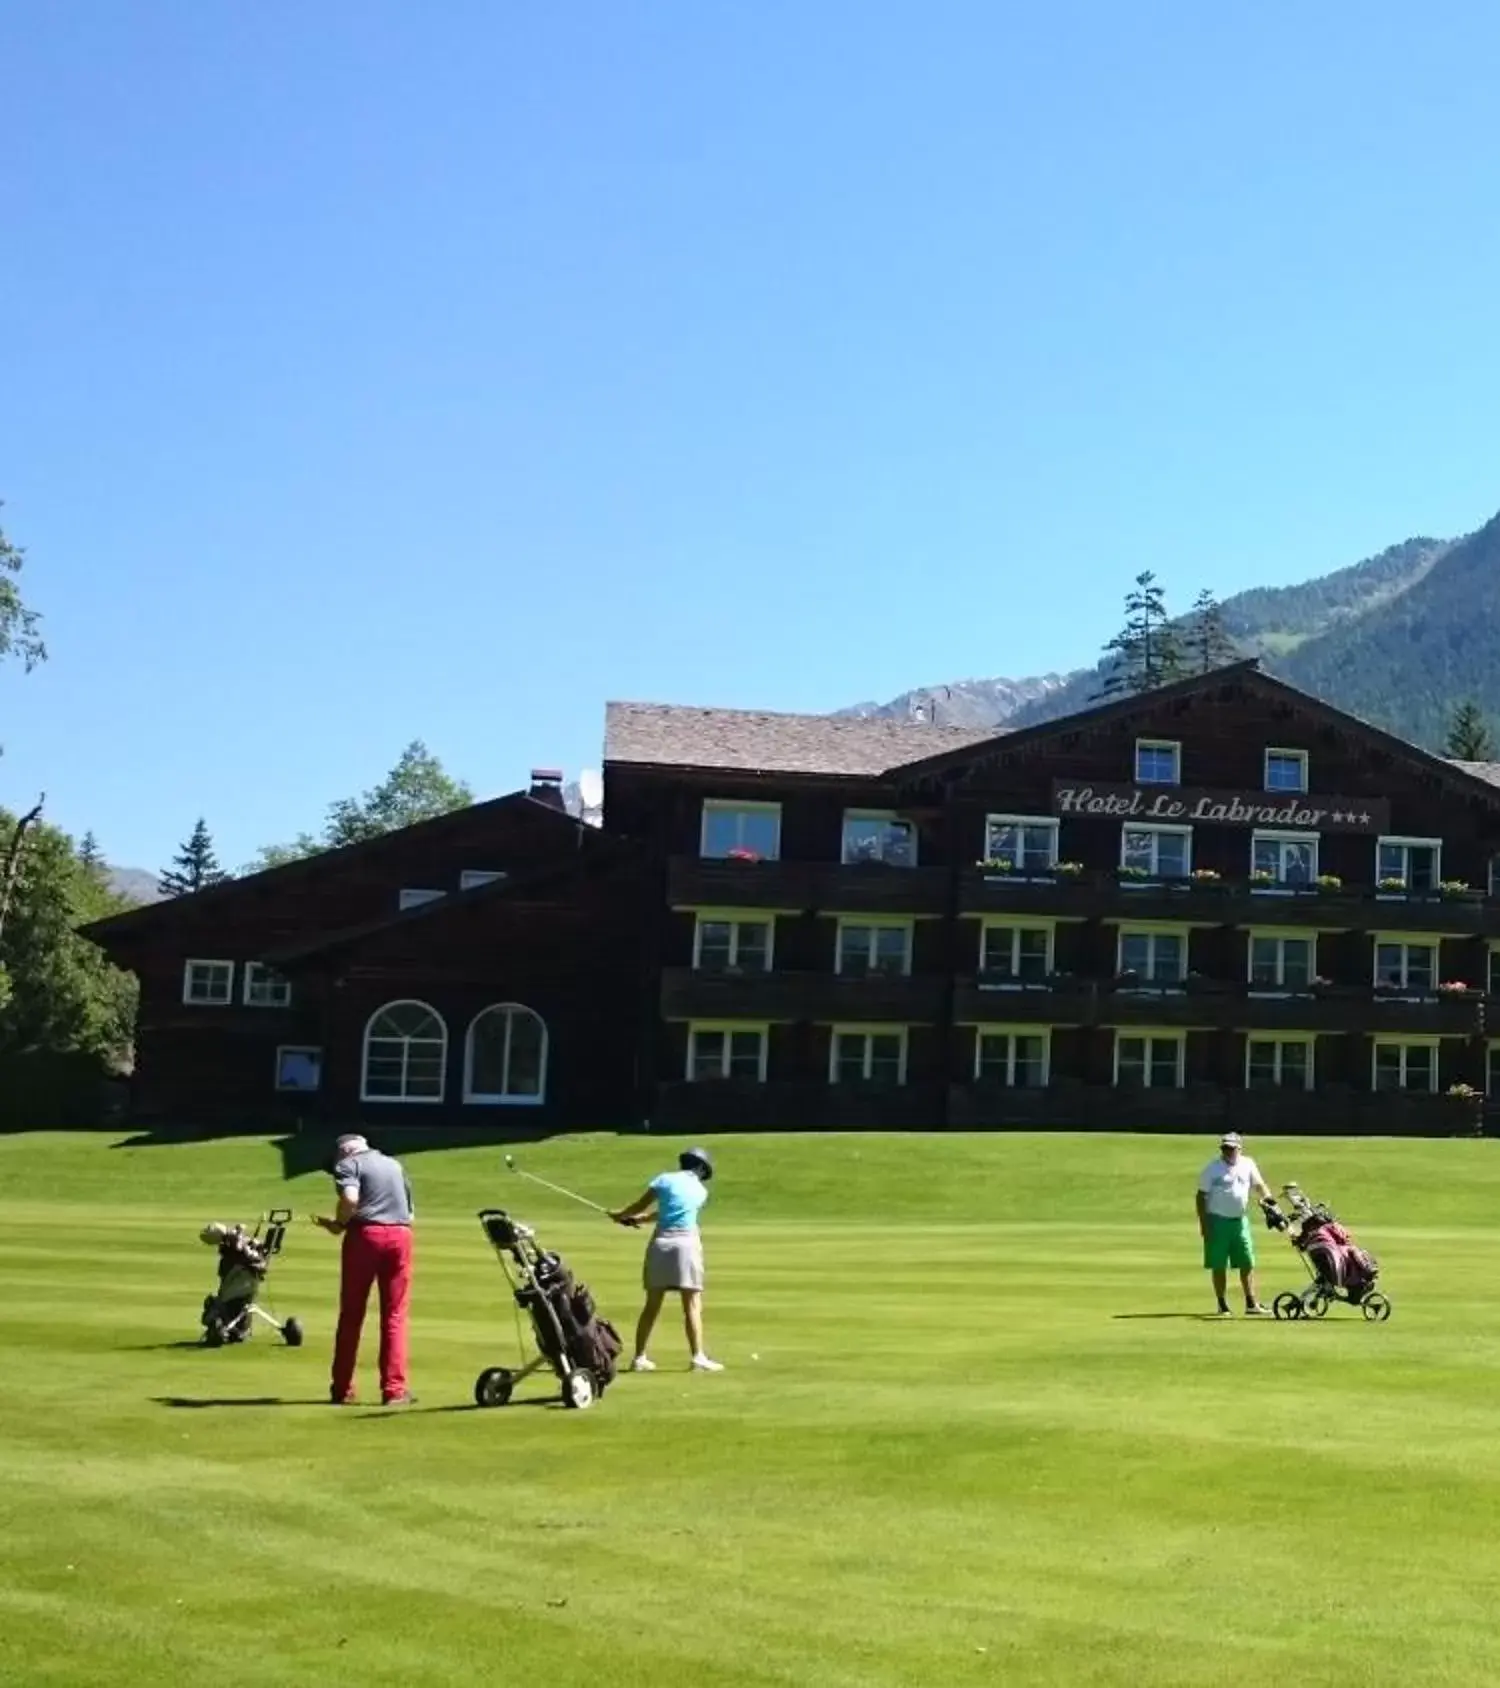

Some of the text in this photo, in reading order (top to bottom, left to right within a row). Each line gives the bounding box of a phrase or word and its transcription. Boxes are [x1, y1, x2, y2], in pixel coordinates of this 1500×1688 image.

[1057, 786, 1327, 825] Hotel Le Labrador
